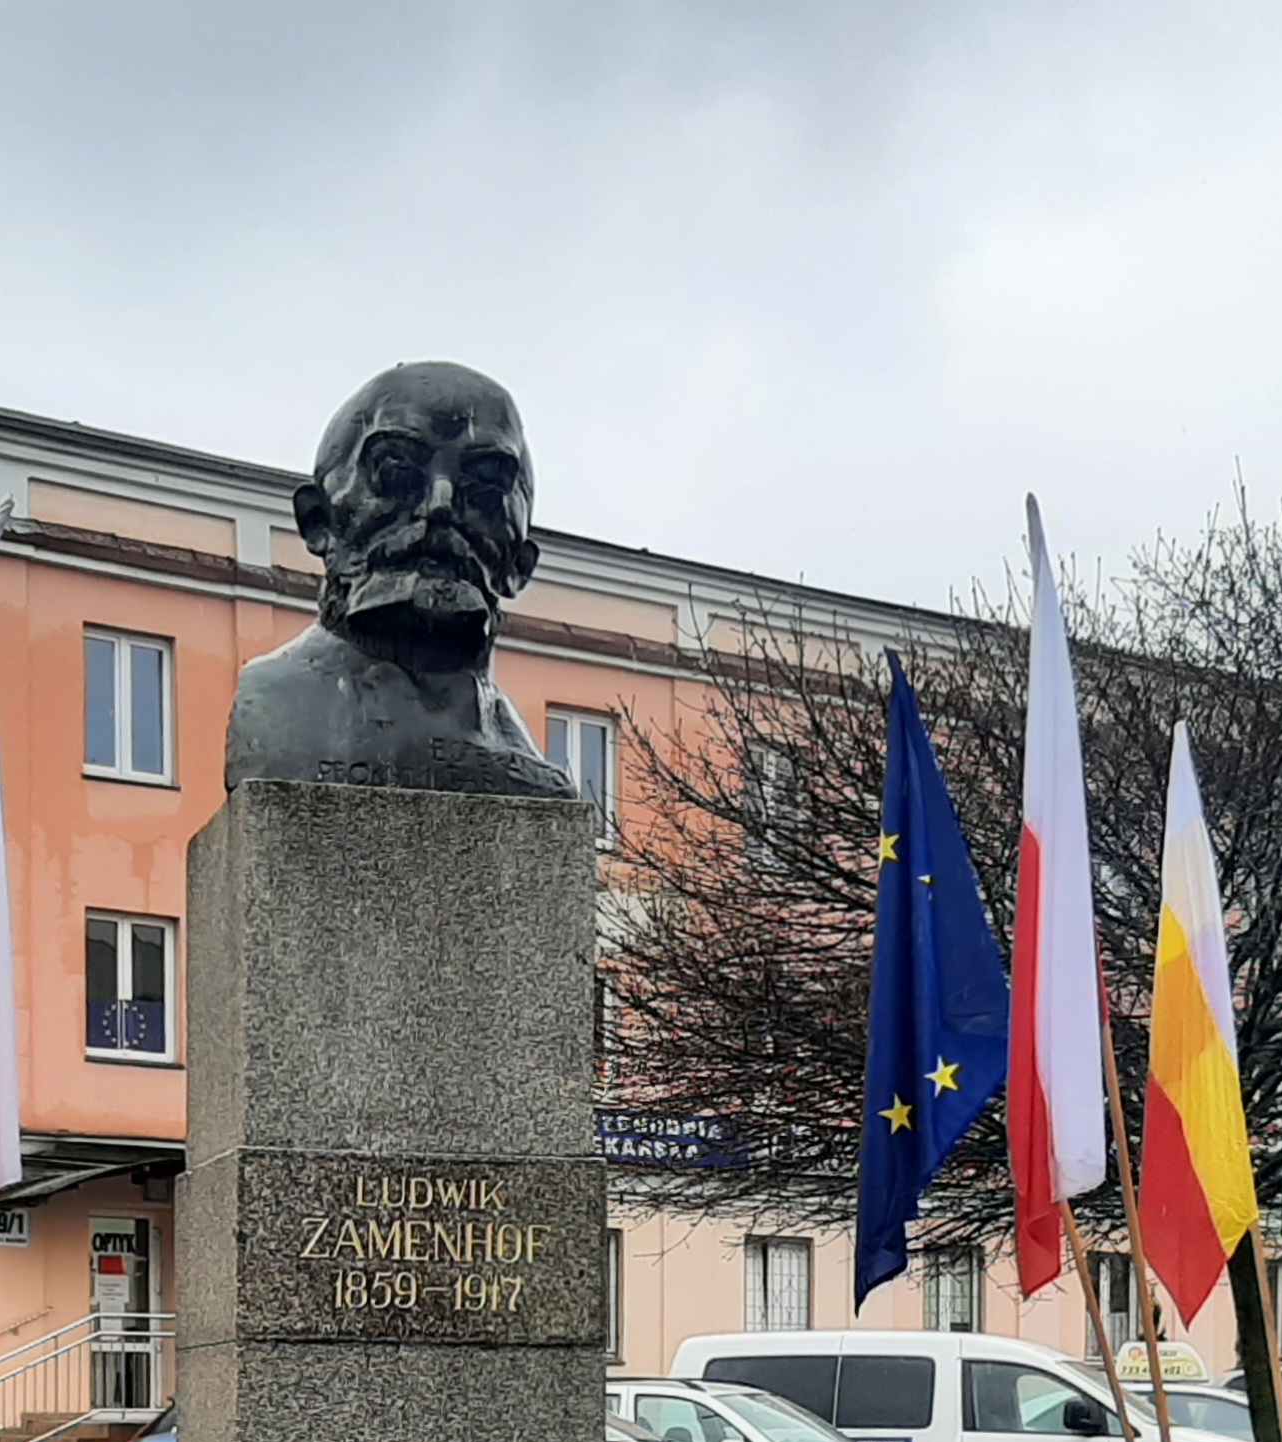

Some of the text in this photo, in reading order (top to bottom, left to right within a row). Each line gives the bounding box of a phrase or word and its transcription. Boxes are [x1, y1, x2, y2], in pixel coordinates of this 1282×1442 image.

[355, 1176, 507, 1210] LUDWIK
[93, 1233, 136, 1254] OPTYK
[299, 1217, 553, 1263] ZAMENHOF
